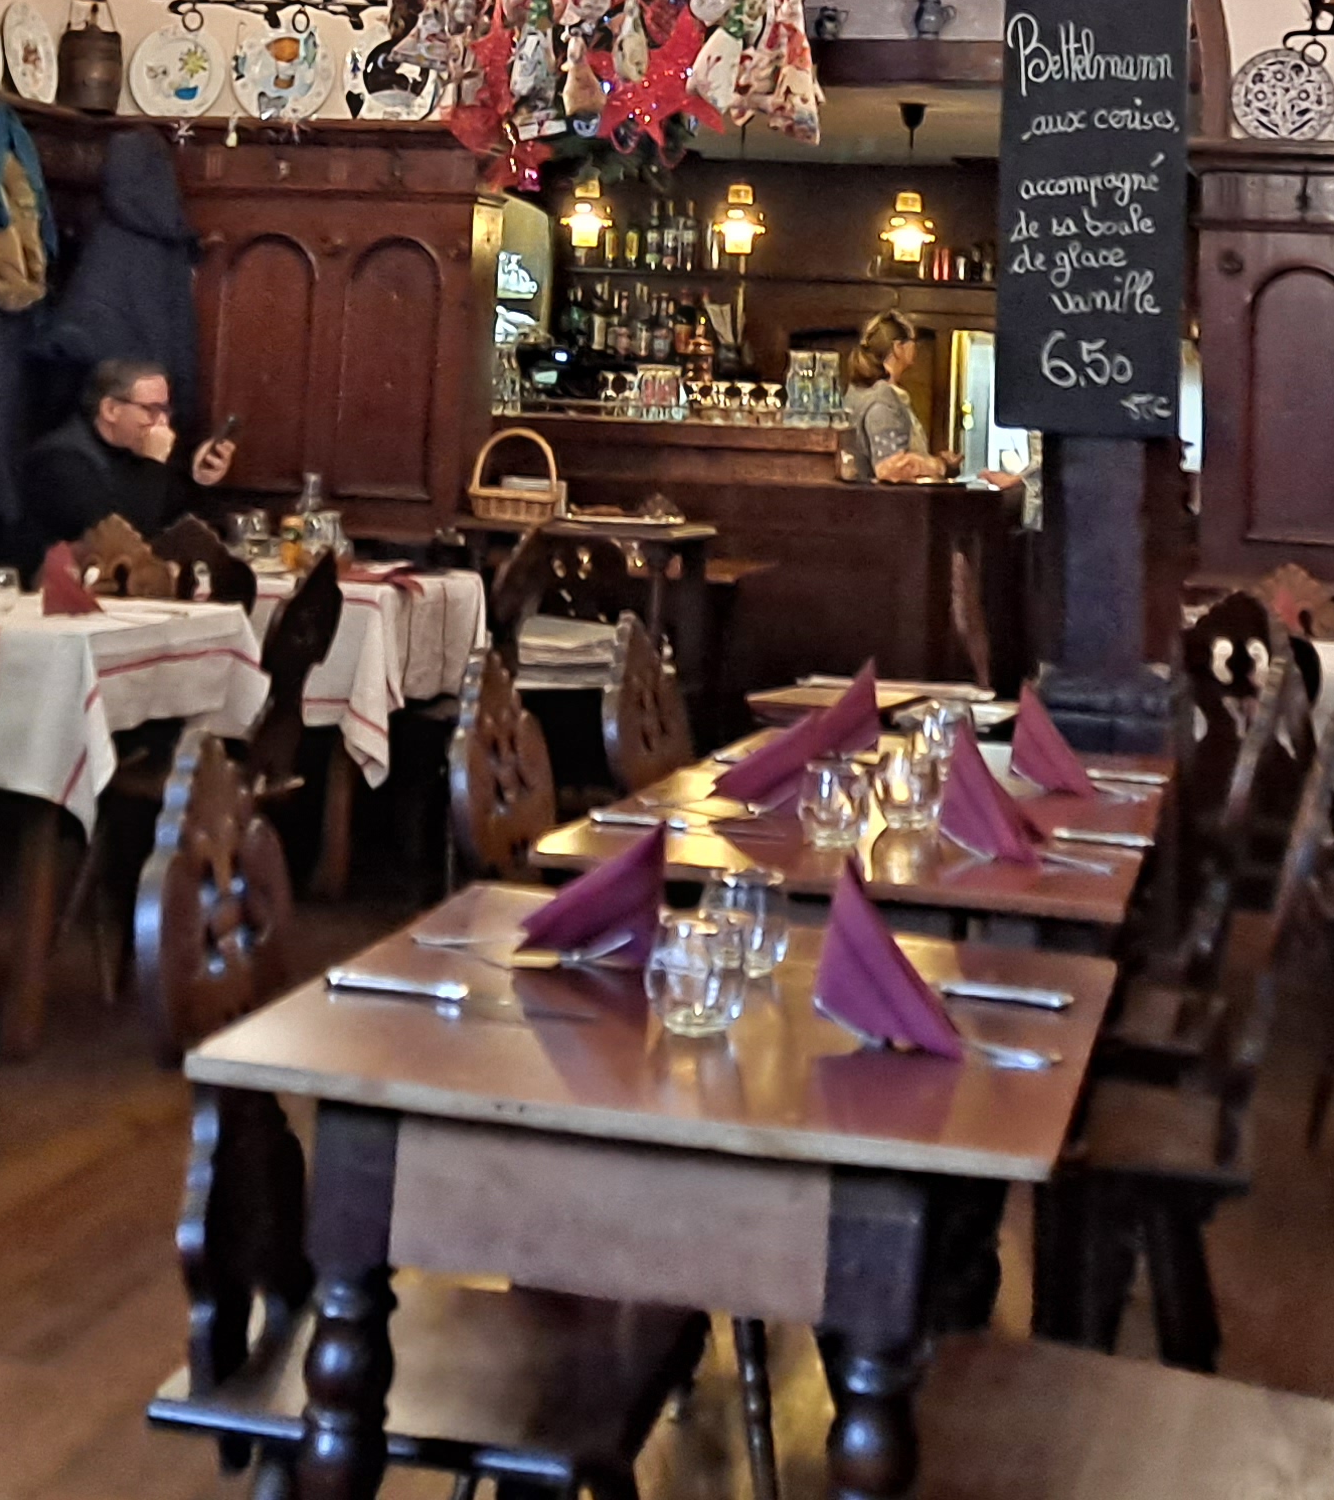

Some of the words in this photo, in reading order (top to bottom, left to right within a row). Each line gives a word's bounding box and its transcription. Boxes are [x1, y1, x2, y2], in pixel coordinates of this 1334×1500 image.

[1007, 13, 1174, 96] Bettelmann
[1023, 110, 1087, 139] aux
[1020, 152, 1165, 206] accompagné
[1010, 210, 1039, 242] de
[1081, 203, 1156, 236] boule
[1010, 244, 1047, 274] de
[1050, 241, 1127, 288] glace
[1050, 270, 1161, 314] vanille
